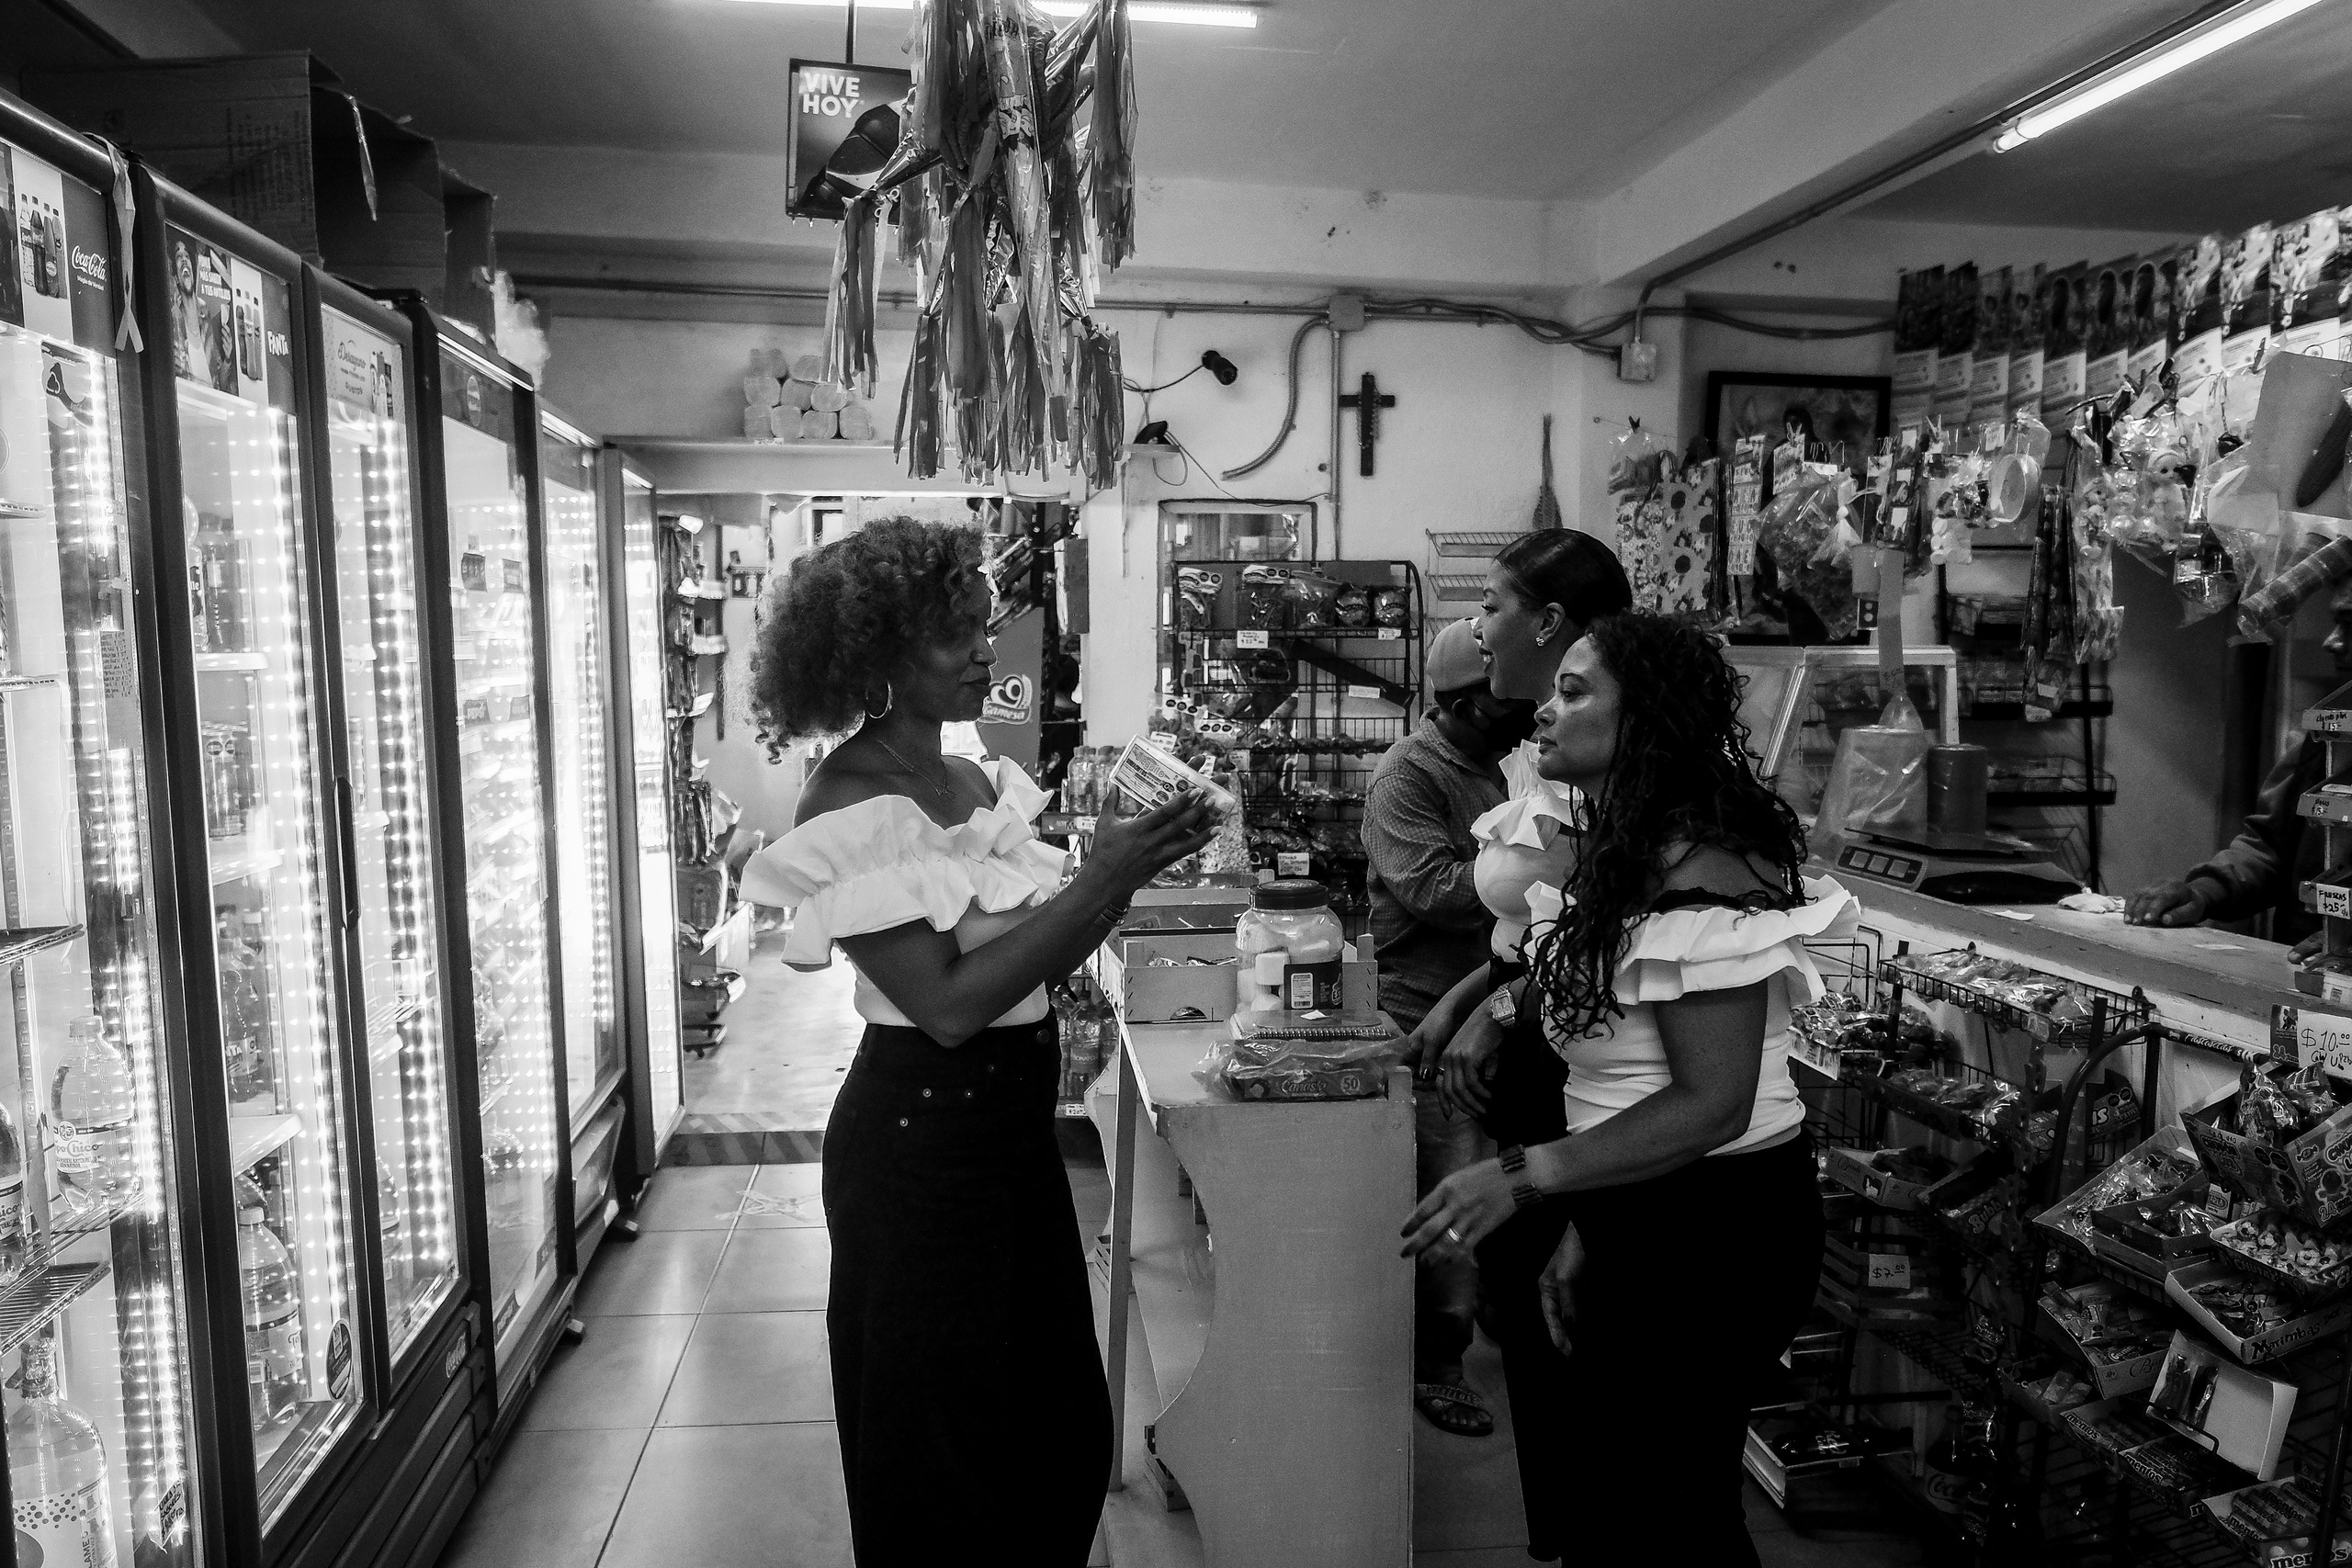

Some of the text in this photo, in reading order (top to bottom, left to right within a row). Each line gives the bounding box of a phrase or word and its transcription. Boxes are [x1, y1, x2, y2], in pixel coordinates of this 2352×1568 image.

[803, 73, 860, 98] VIVE
[802, 94, 859, 118] HOY
[72, 245, 107, 281] Coca-Cola
[1343, 1077, 1359, 1090] 50
[67, 1140, 103, 1157] Chico
[1968, 1199, 2007, 1235] Bubb
[2251, 1323, 2321, 1361] Marimbas
[2067, 1414, 2101, 1440] mentos
